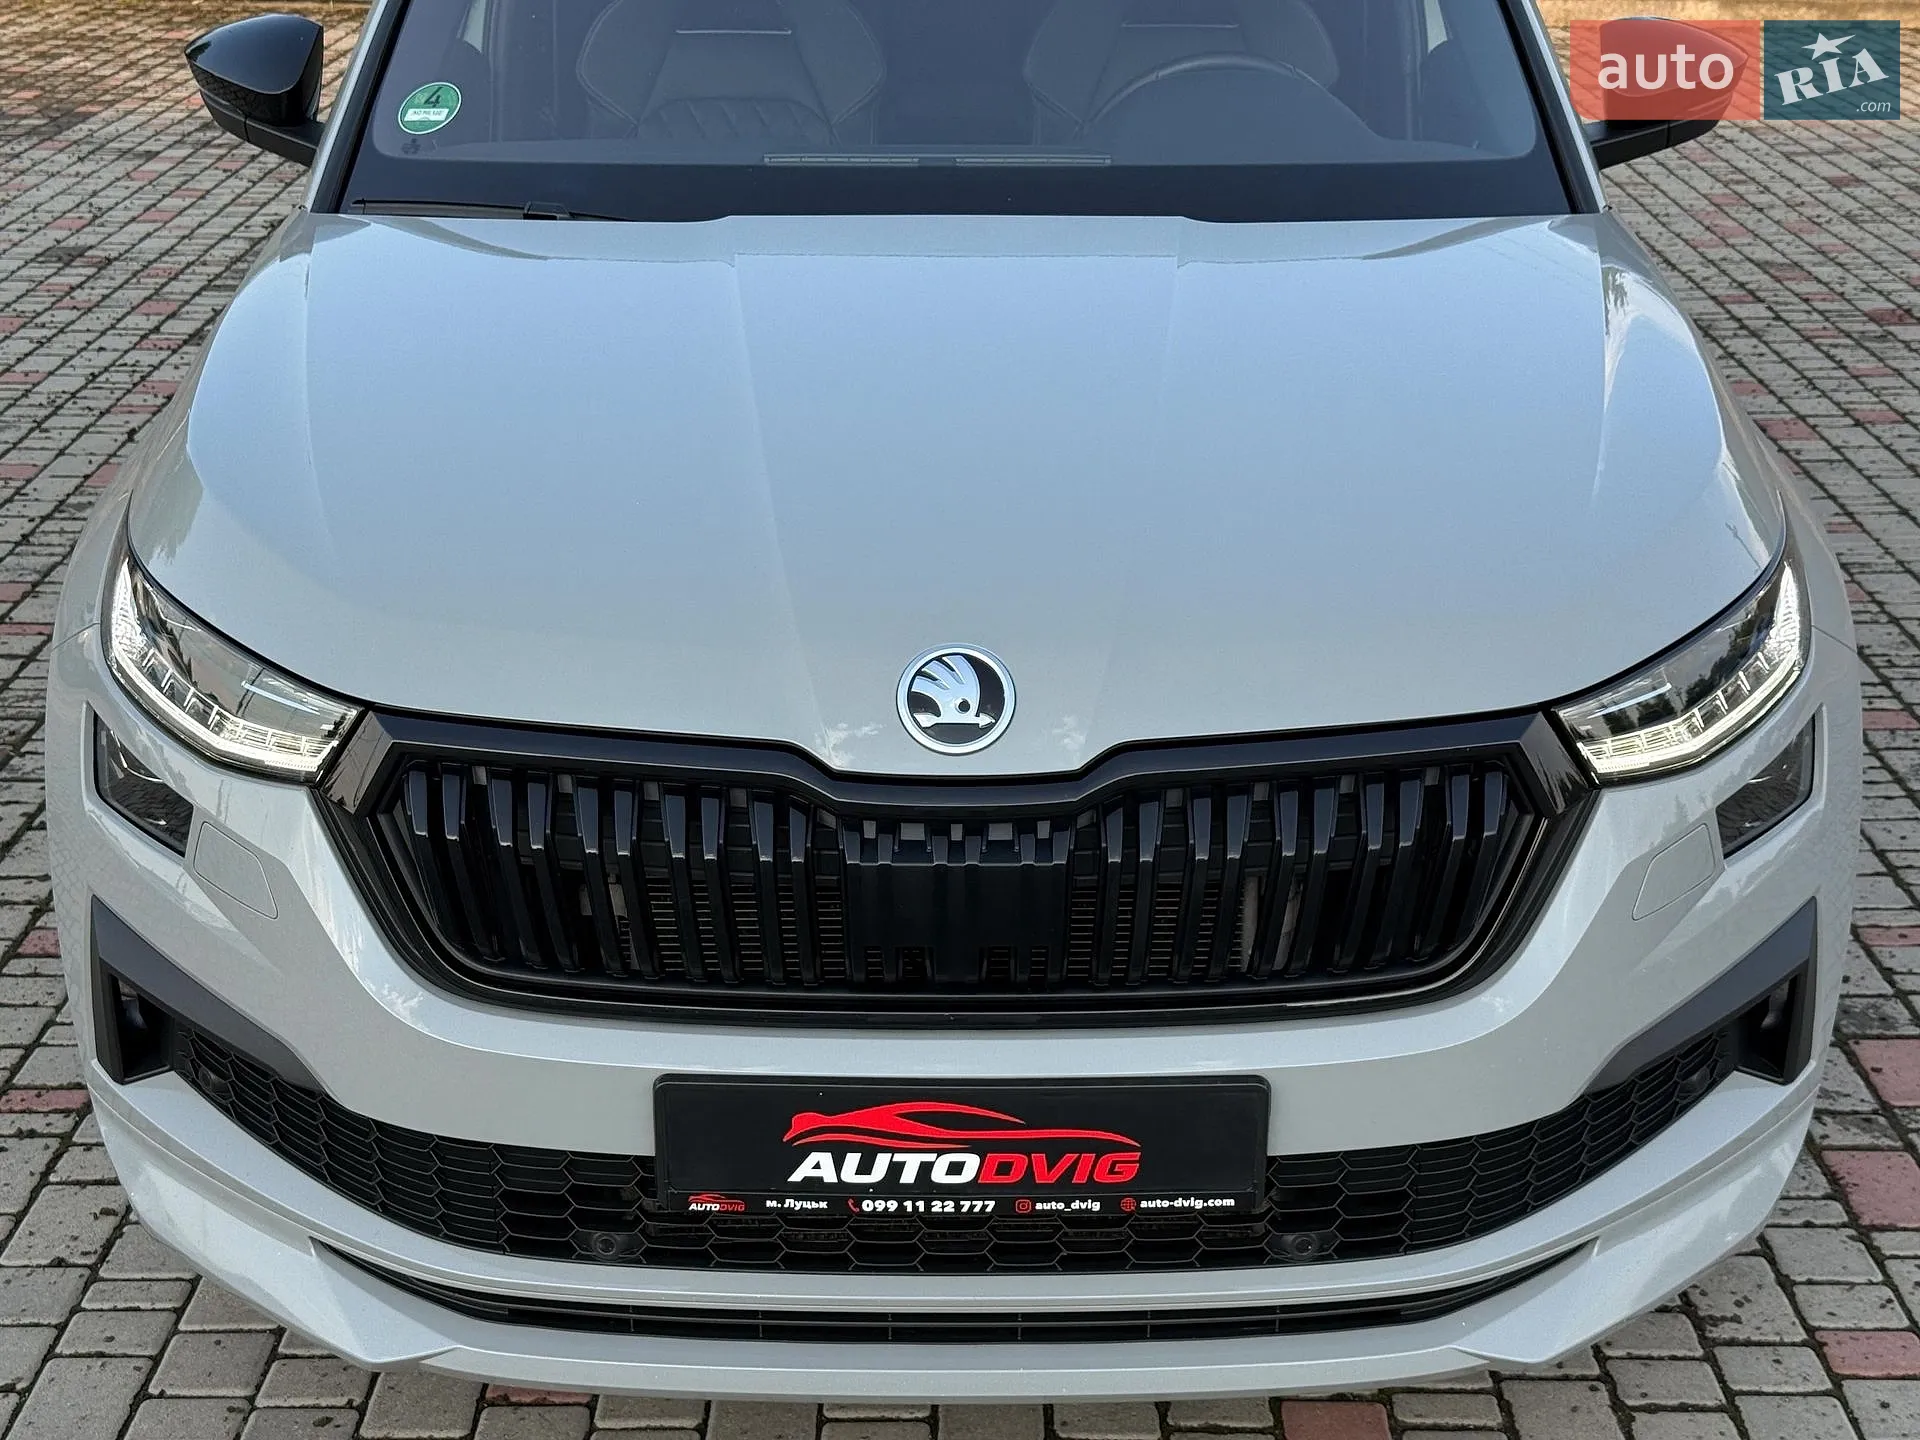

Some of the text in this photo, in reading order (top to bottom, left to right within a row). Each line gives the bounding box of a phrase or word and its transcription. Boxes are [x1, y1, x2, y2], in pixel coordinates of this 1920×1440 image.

[423, 86, 443, 107] 4
[787, 1152, 1141, 1183] AUTODVIG
[765, 1198, 828, 1211] м. Луцьк
[862, 1199, 996, 1213] 099 11 22 777
[1035, 1199, 1101, 1212] auto_dvig
[1140, 1197, 1235, 1210] auto-dvig.com
